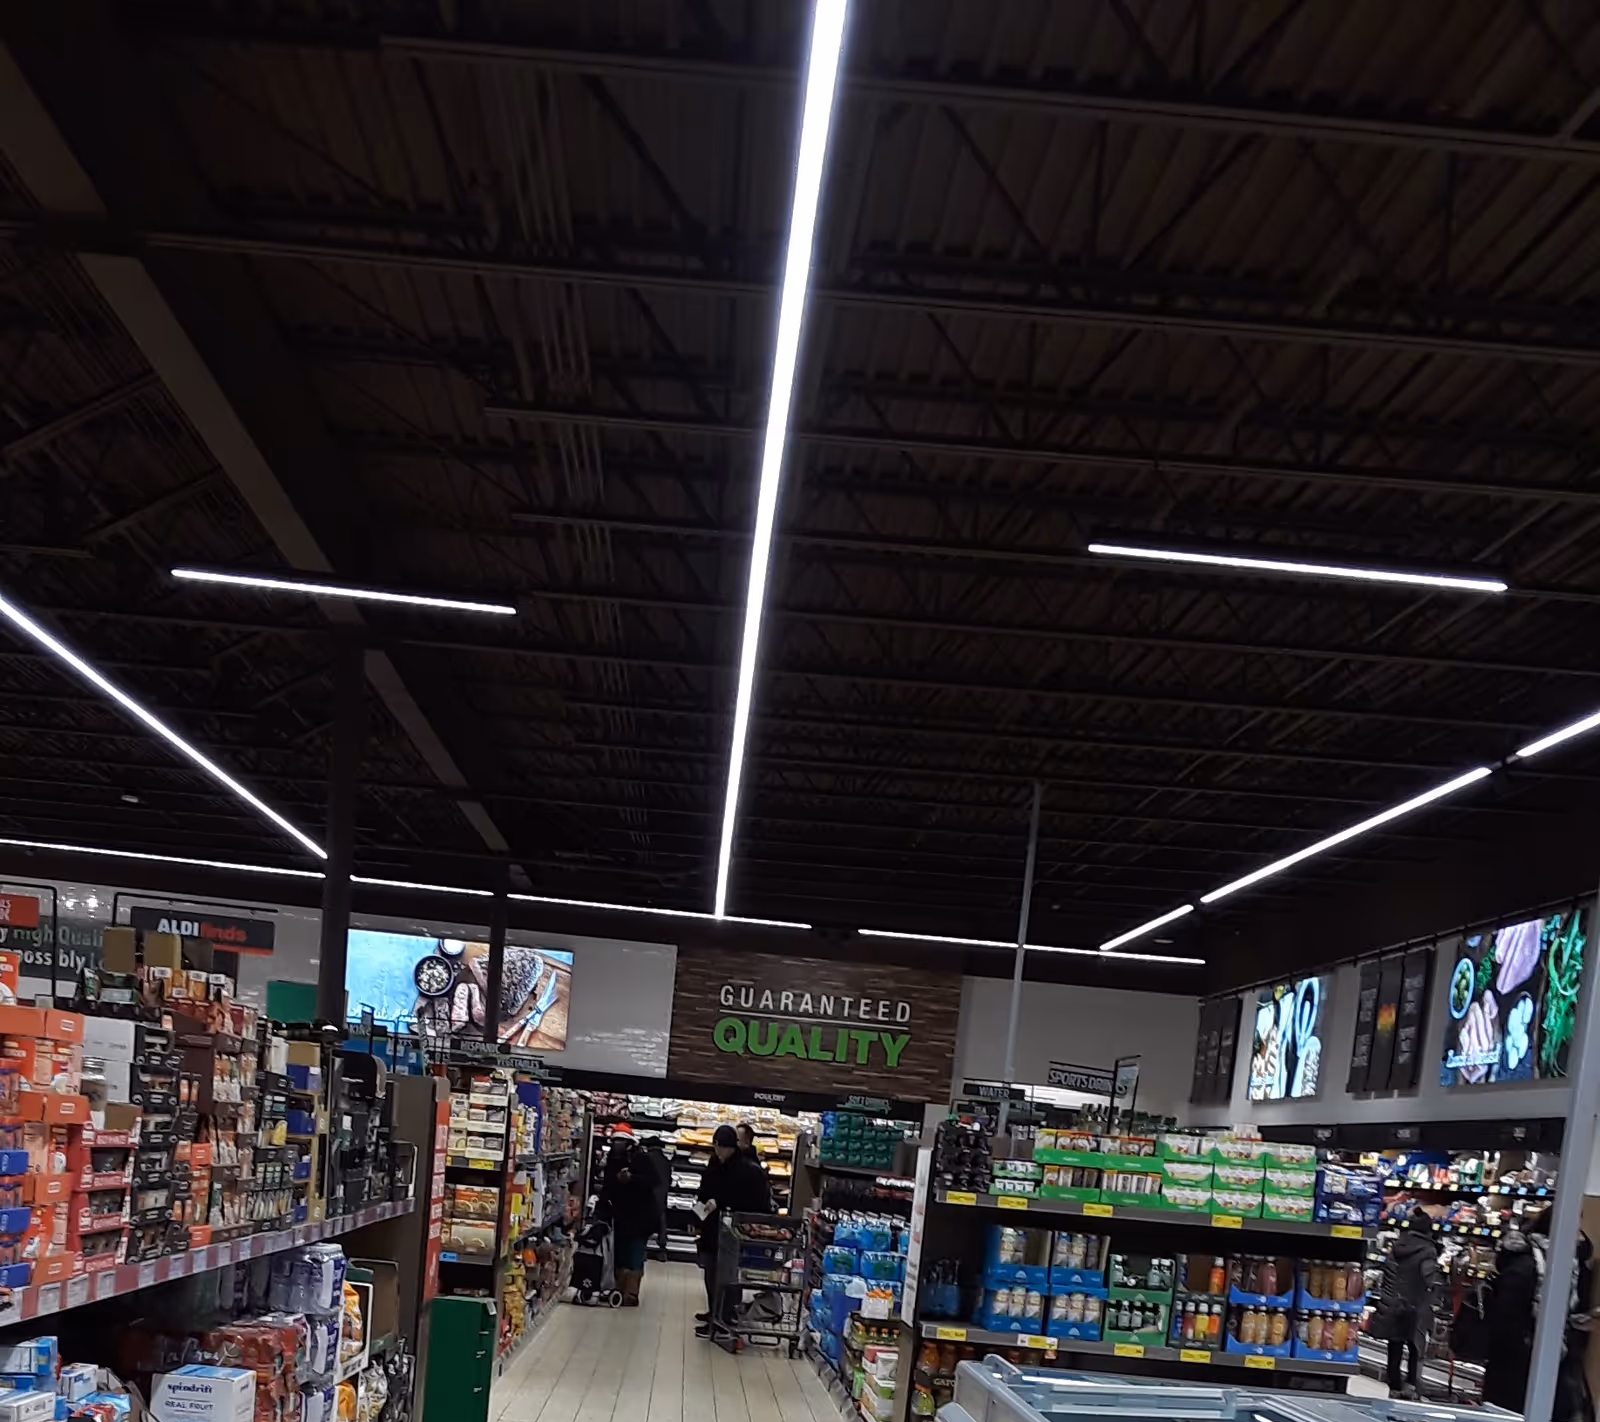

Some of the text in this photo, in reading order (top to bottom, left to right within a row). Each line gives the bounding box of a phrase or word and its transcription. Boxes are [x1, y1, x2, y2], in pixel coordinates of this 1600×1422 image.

[157, 917, 200, 937] ALDI
[58, 925, 104, 946] Quali
[720, 984, 911, 1023] GUARANTEED
[460, 1040, 501, 1054] HISPANIC
[713, 1016, 911, 1068] QUALITY
[1047, 1069, 1127, 1095] SPORTS DRINS
[753, 1092, 786, 1103] POULTRY
[978, 1086, 1010, 1099] WATER
[167, 1381, 213, 1394] spindrift
[933, 1378, 956, 1387] GATO
[165, 1400, 213, 1411] REAL FRUIT
